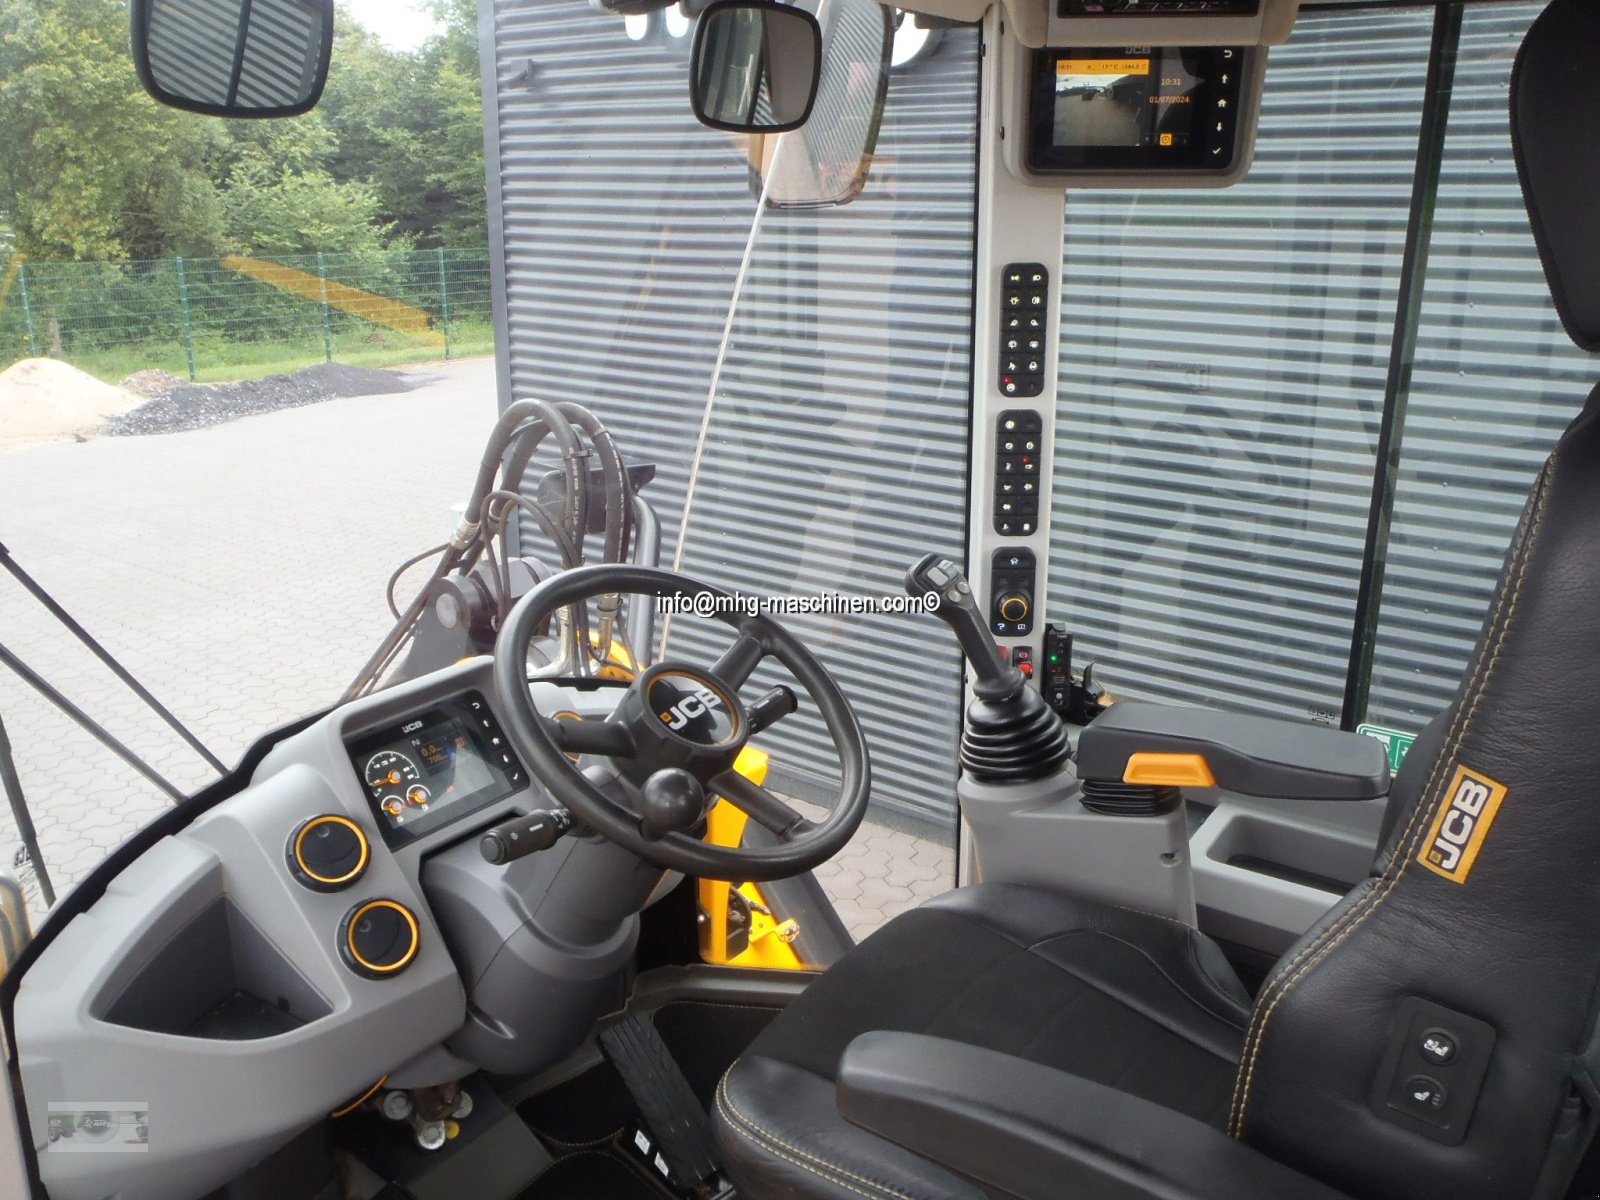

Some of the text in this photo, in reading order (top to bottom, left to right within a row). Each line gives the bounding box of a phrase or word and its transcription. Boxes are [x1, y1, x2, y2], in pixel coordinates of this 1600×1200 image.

[1160, 78, 1180, 86] 10:31
[1149, 95, 1190, 104] 01/07/2024
[668, 687, 722, 731] JCB
[401, 720, 424, 734] JCB
[1435, 779, 1489, 870] JCB
